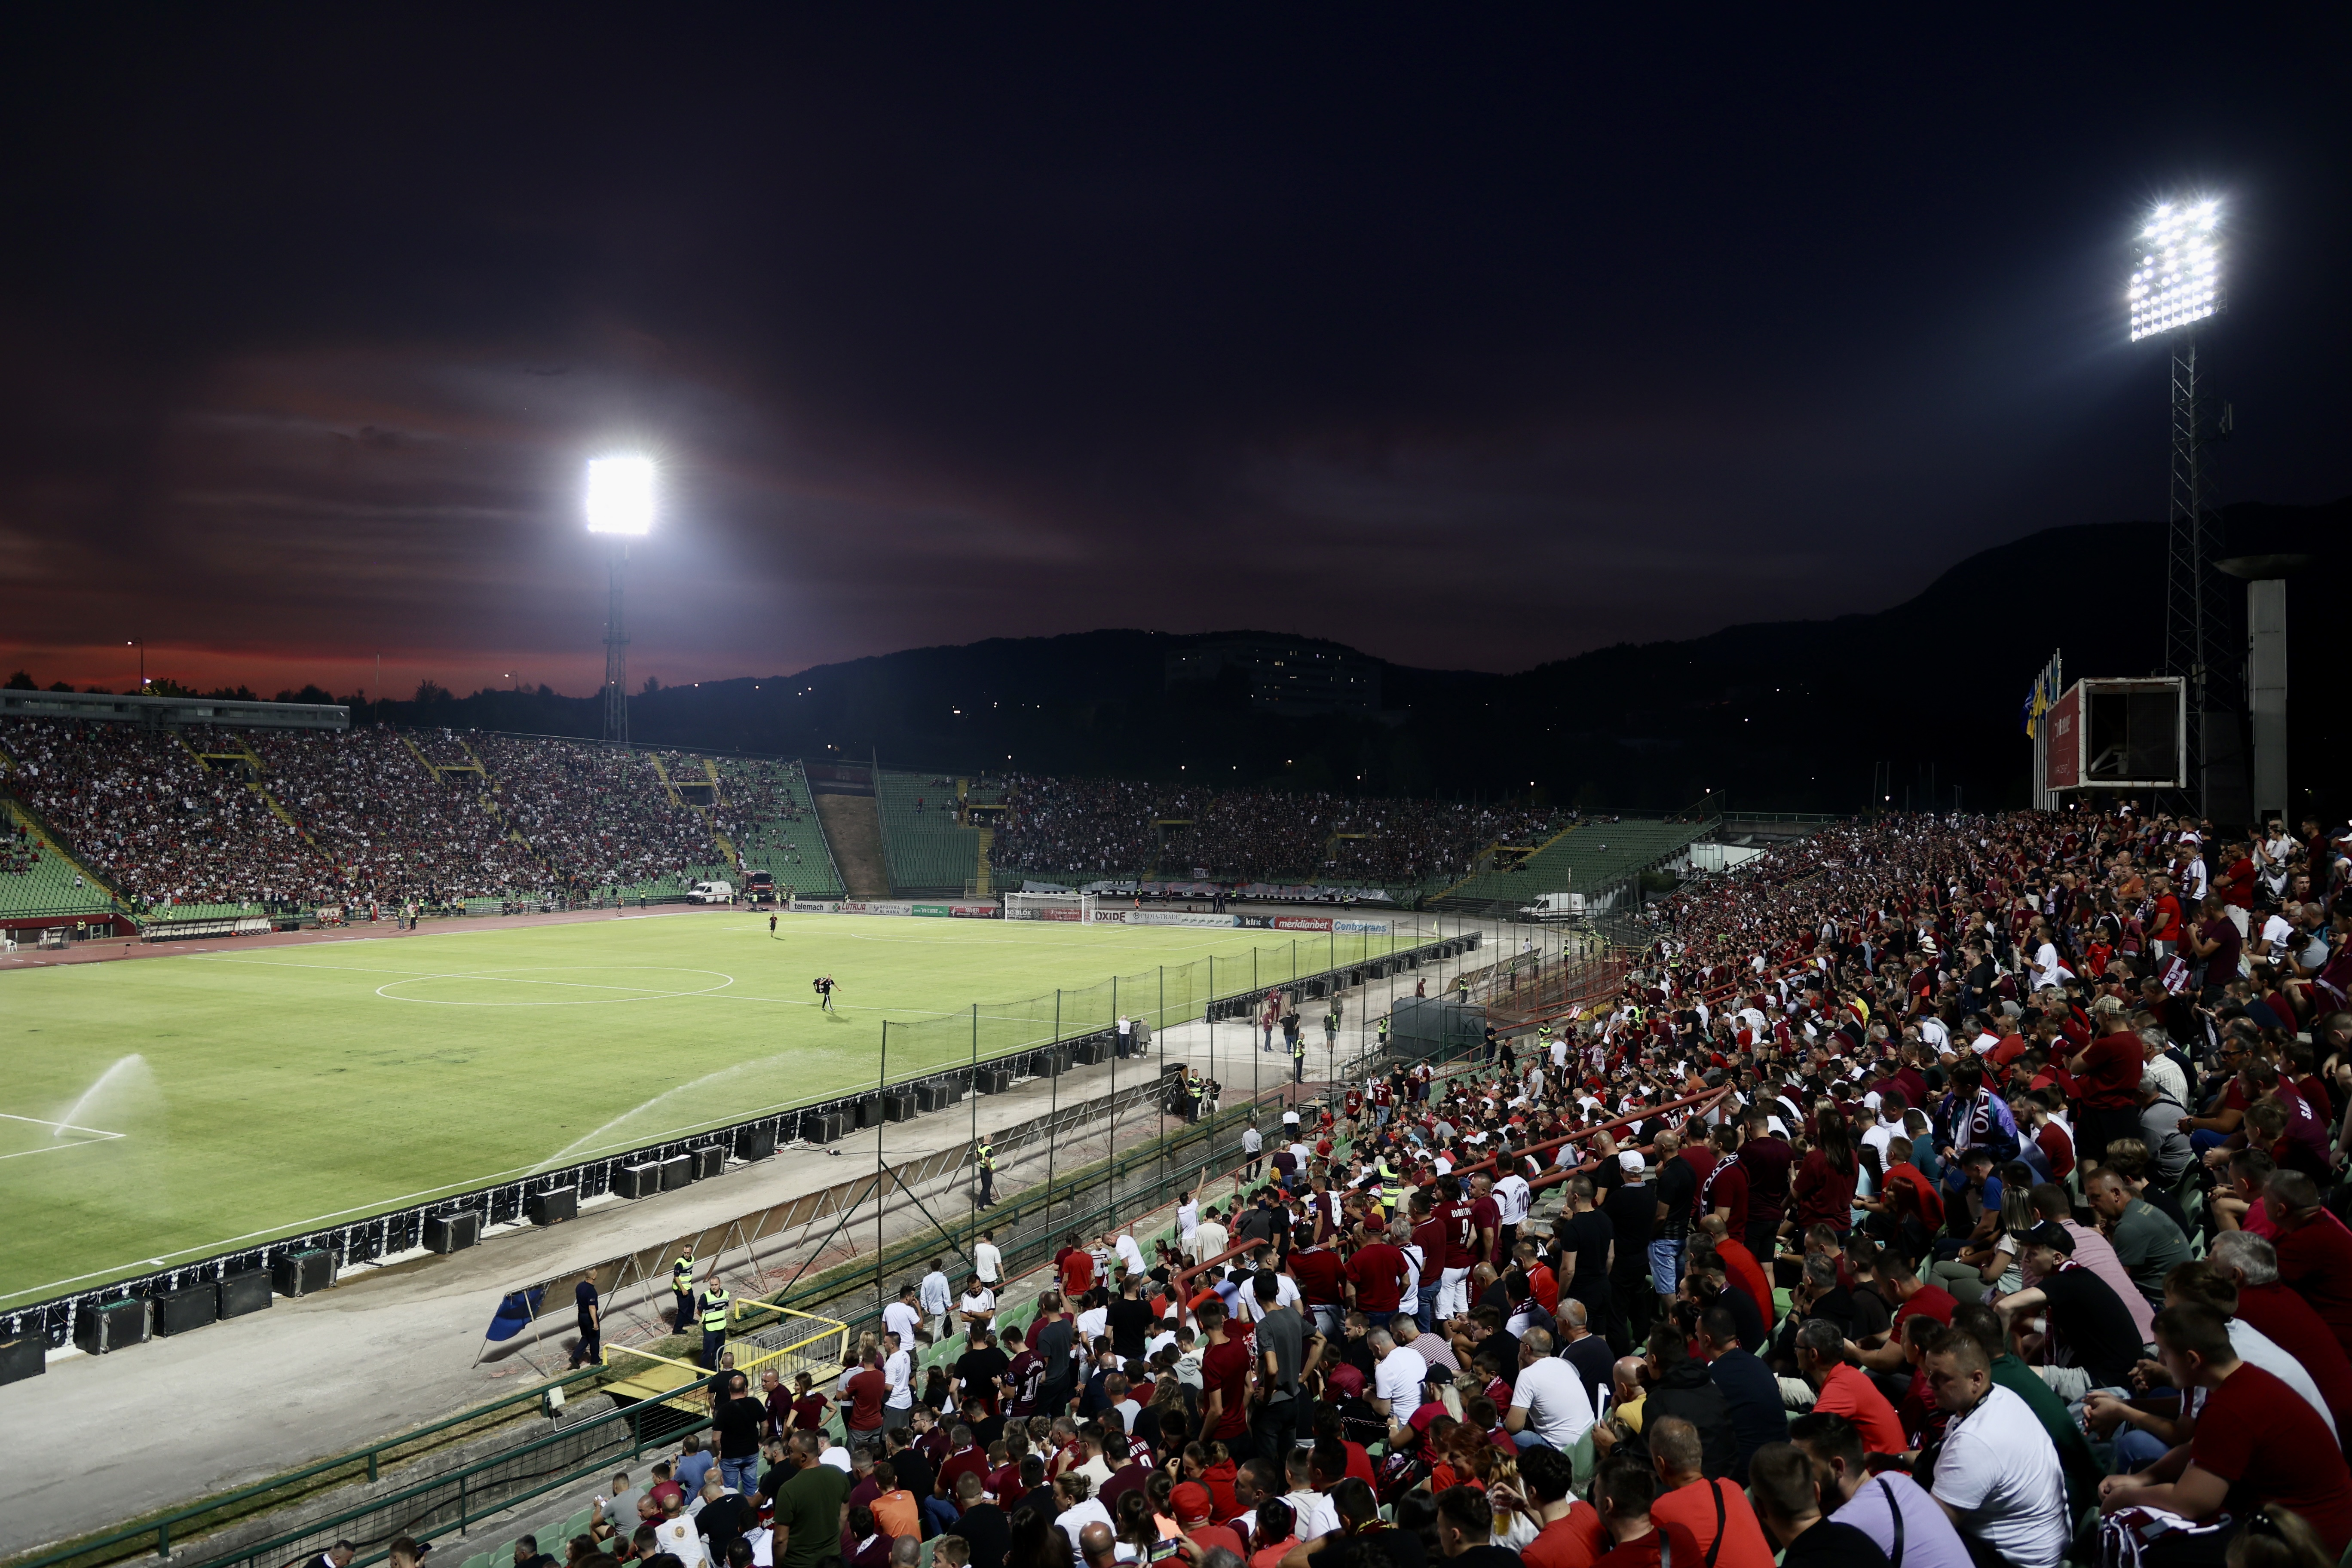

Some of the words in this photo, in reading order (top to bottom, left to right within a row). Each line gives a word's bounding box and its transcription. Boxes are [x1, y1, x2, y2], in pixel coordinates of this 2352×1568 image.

[1095, 911, 1126, 922] OXIDE
[1279, 920, 1328, 929] meridianbet
[1334, 921, 1387, 932] Centrotrans
[1378, 1091, 1382, 1100] 5
[1460, 1219, 1469, 1244] 9
